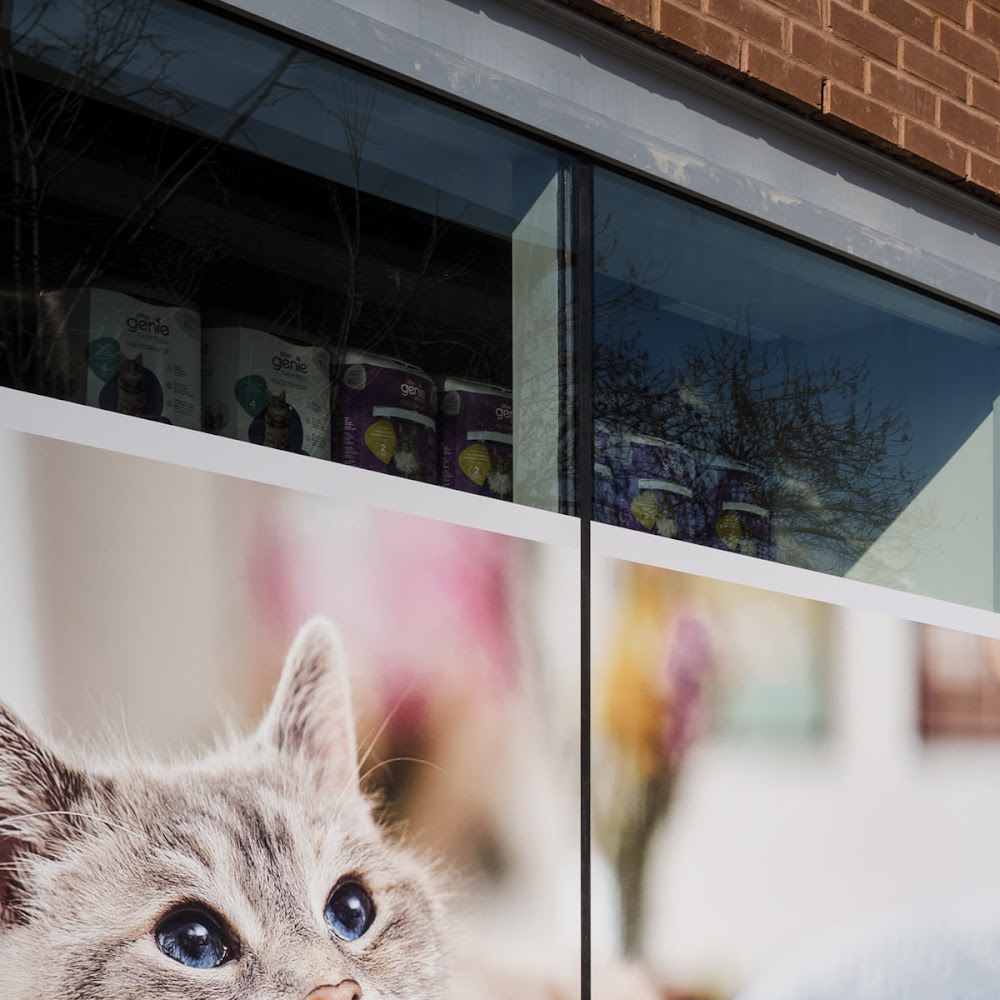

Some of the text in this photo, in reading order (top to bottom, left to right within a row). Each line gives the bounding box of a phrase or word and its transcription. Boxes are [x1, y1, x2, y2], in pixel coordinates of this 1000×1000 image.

[127, 317, 170, 336] genie
[272, 355, 308, 374] genie
[380, 444, 386, 453] 2
[473, 466, 480, 474] 2
